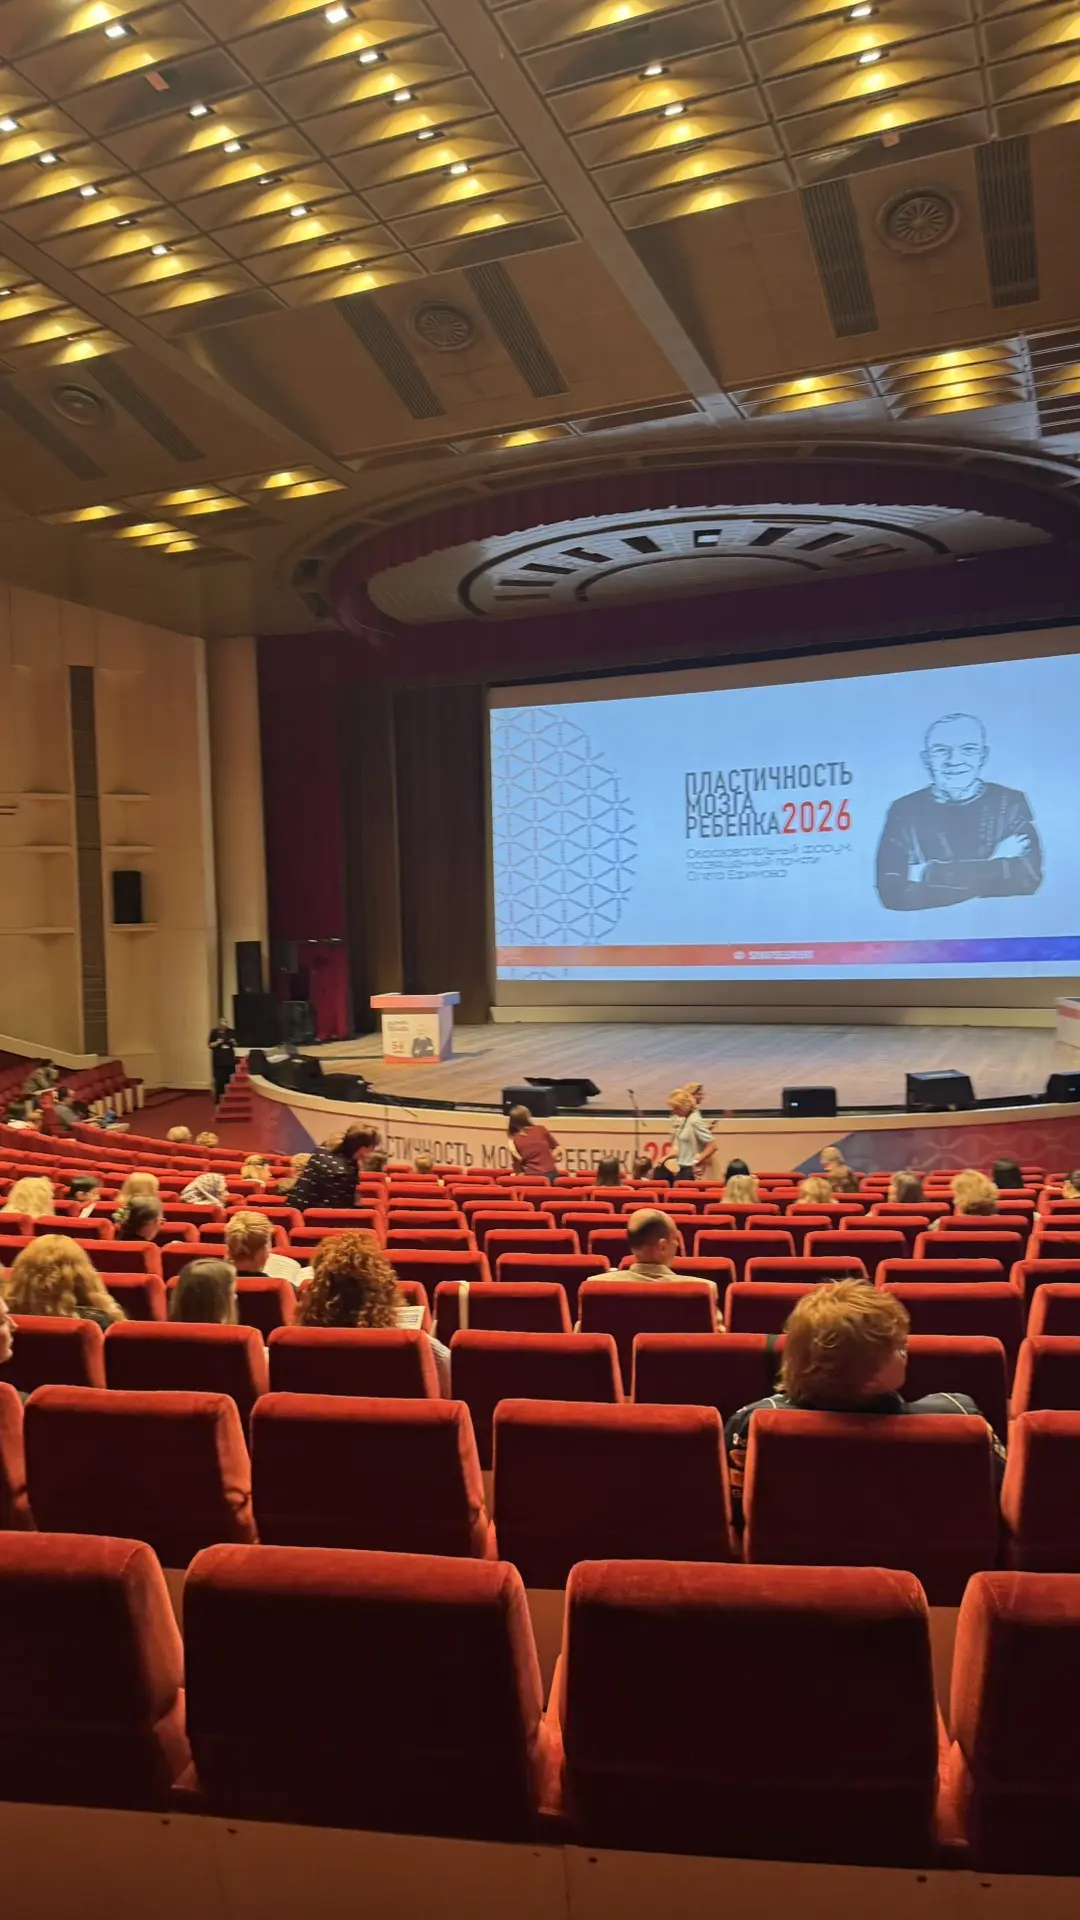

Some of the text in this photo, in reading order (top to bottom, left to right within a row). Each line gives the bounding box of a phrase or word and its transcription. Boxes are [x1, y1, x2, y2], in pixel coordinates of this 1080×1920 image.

[685, 762, 853, 795] ПЛАСТИЧНОСТЬ
[685, 799, 851, 838] РЕБЕНКА 2026
[686, 791, 757, 817] МОЗГА
[386, 1135, 473, 1167] СТИЧНОСТЬ
